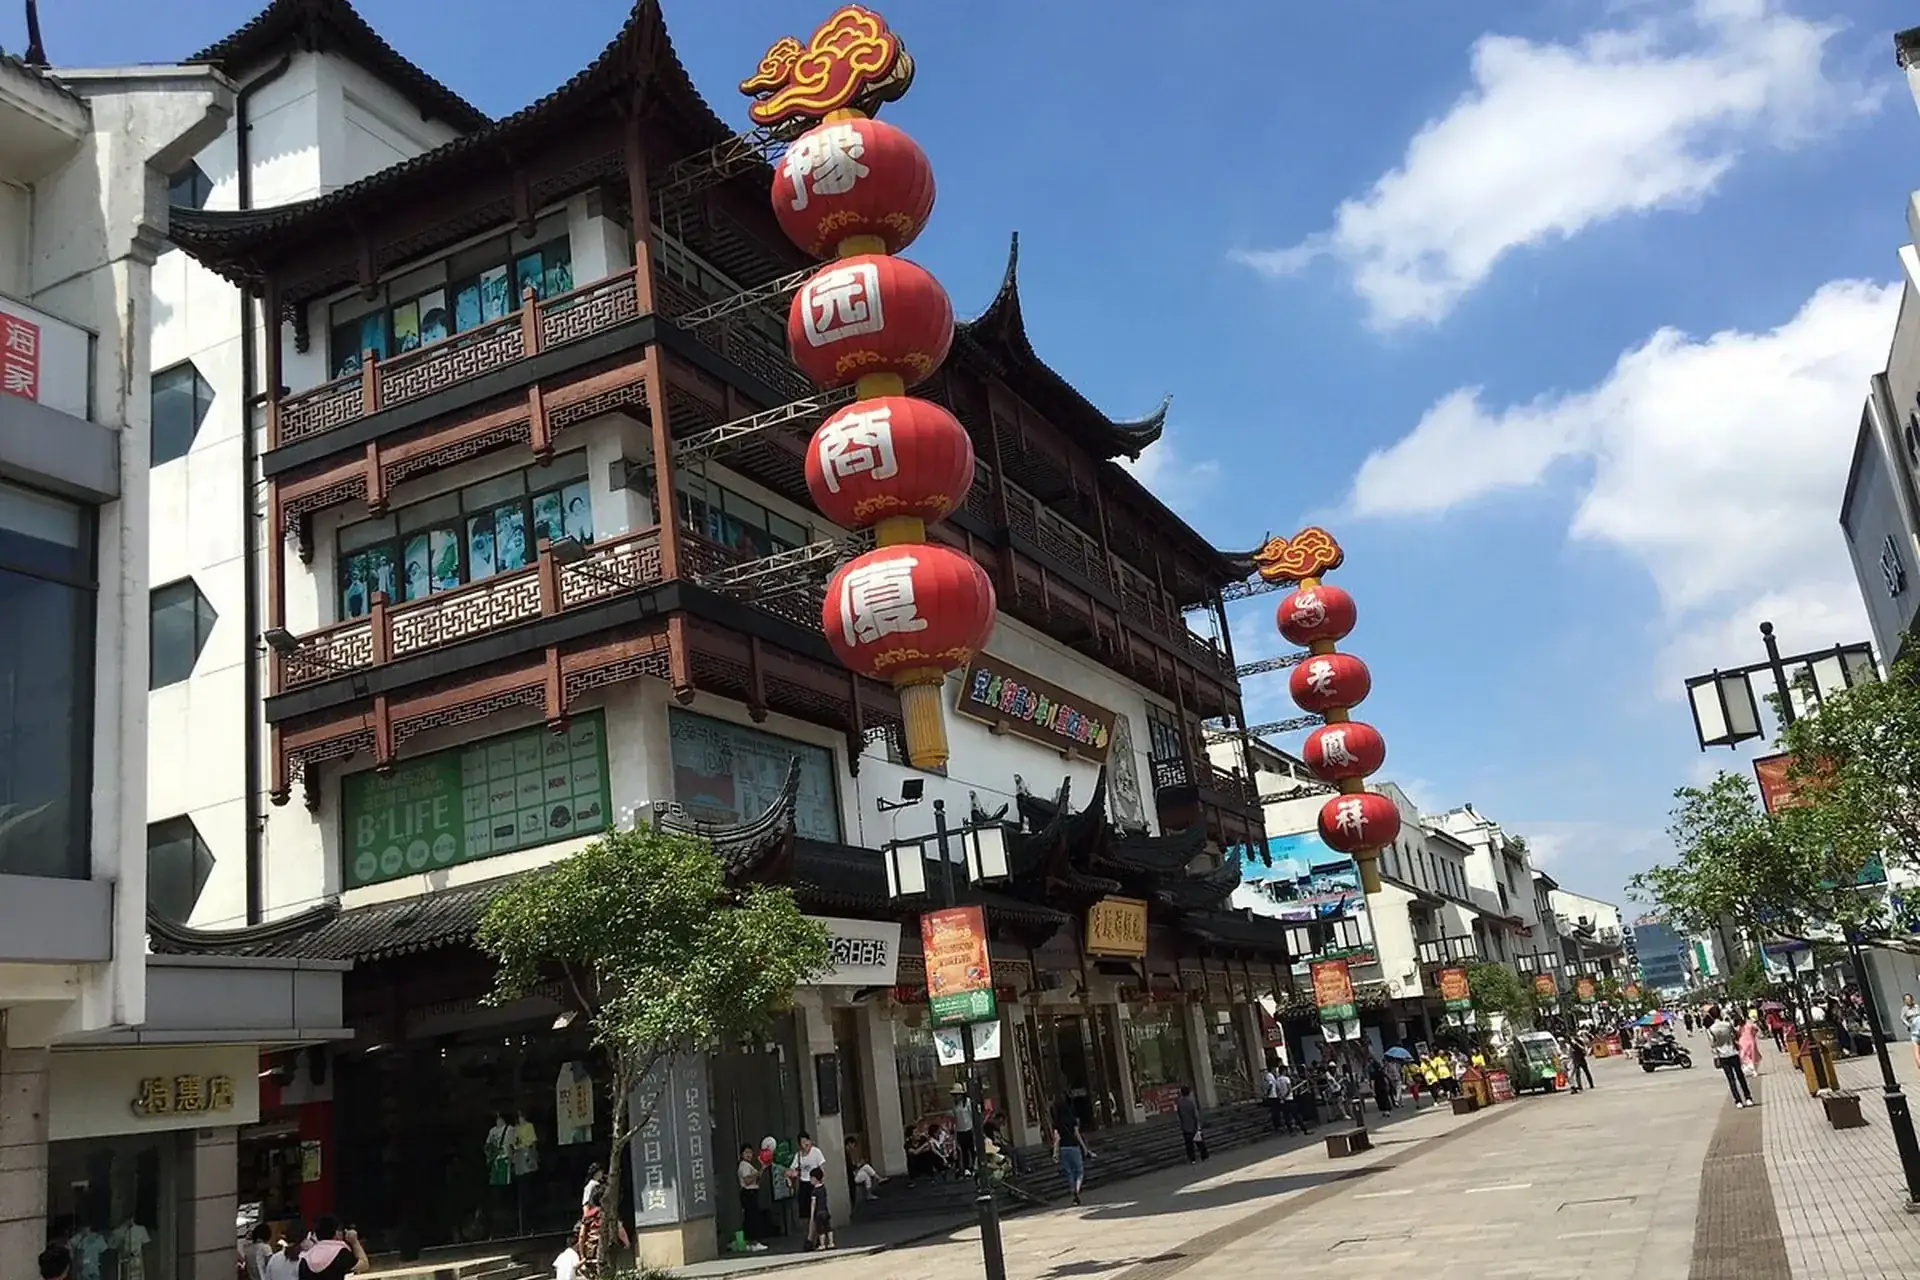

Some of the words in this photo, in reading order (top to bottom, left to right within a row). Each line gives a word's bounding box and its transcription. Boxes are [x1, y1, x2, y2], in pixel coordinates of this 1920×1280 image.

[4, 319, 36, 398] 海一家
[784, 124, 928, 648] 豫园商厦
[139, 1076, 233, 1113] 特惠店
